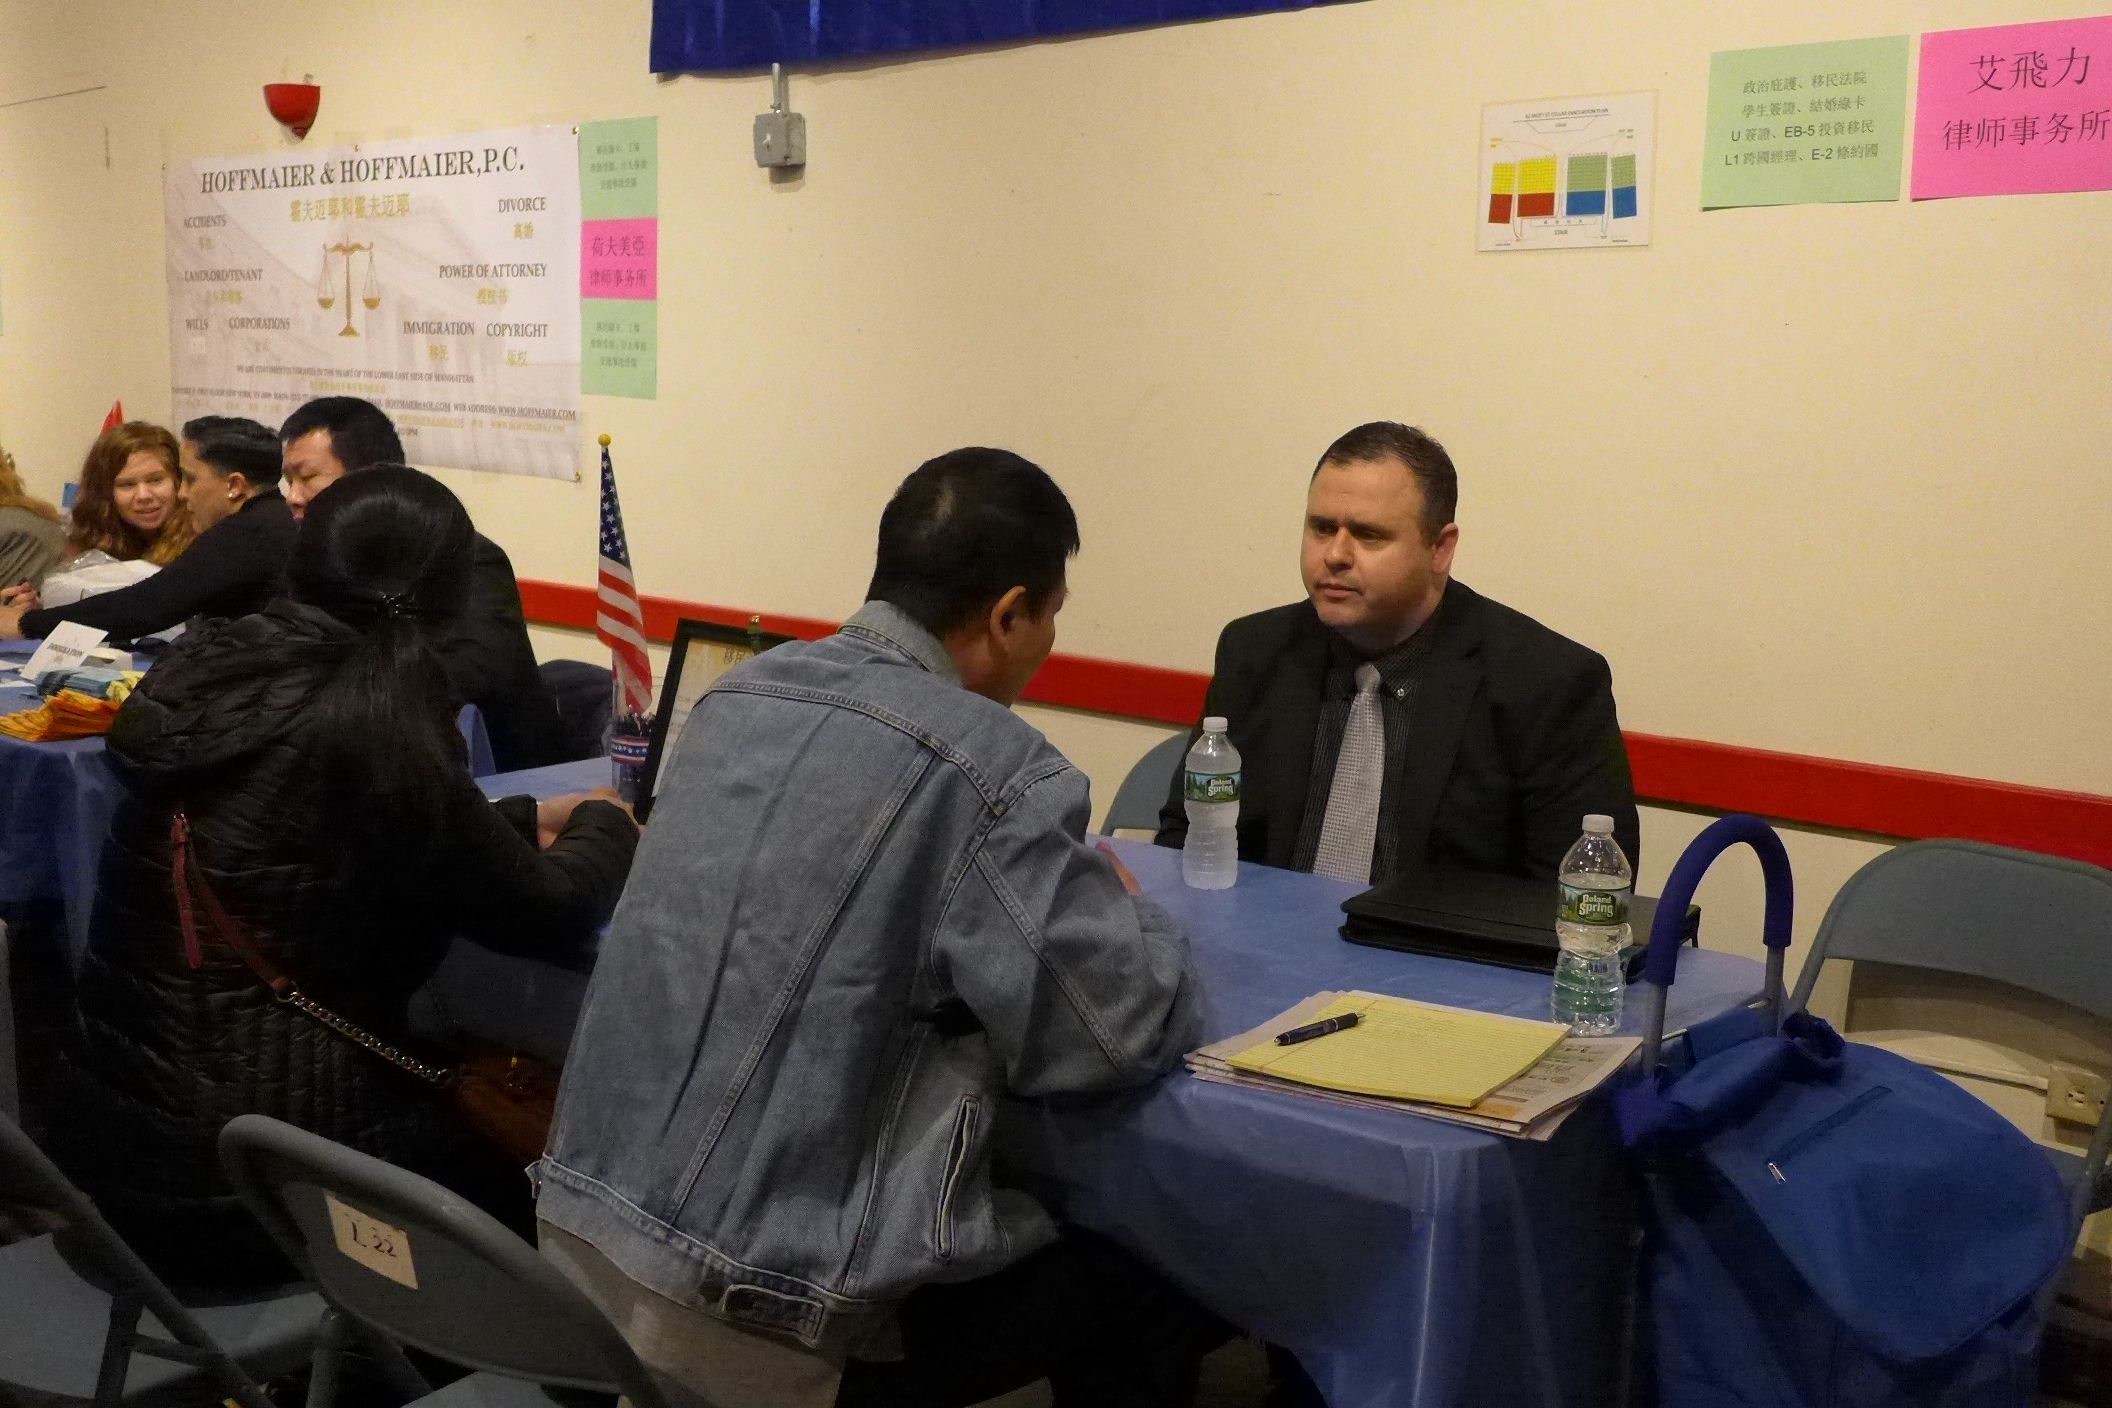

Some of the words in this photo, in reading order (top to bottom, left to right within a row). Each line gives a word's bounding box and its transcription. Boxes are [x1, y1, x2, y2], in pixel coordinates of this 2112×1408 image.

[1966, 46, 2090, 94] 艾飛力
[1731, 129, 1741, 142] U
[1784, 124, 1816, 138] EB-5
[1942, 109, 2111, 150] 律师事务所
[1724, 154, 1739, 166] L1
[1811, 147, 1834, 161] E-2
[200, 164, 314, 193] HOFFMAIER
[319, 162, 334, 184] &
[340, 146, 524, 182] HOFFMAIER,P.C.
[498, 196, 547, 213] DIVORCE
[184, 214, 227, 228] ACCIDENTS
[439, 264, 475, 279] POWER
[476, 264, 490, 278] OF
[492, 262, 547, 278] ATTORNEY
[185, 318, 208, 330] WILLS
[228, 317, 290, 331] CORPORATIONS
[403, 321, 475, 336] IMMIGRATION
[486, 322, 548, 338] COPYRIGHT
[1207, 784, 1234, 797] Spring
[1582, 894, 1612, 903] Poland
[1579, 902, 1614, 917] Spring
